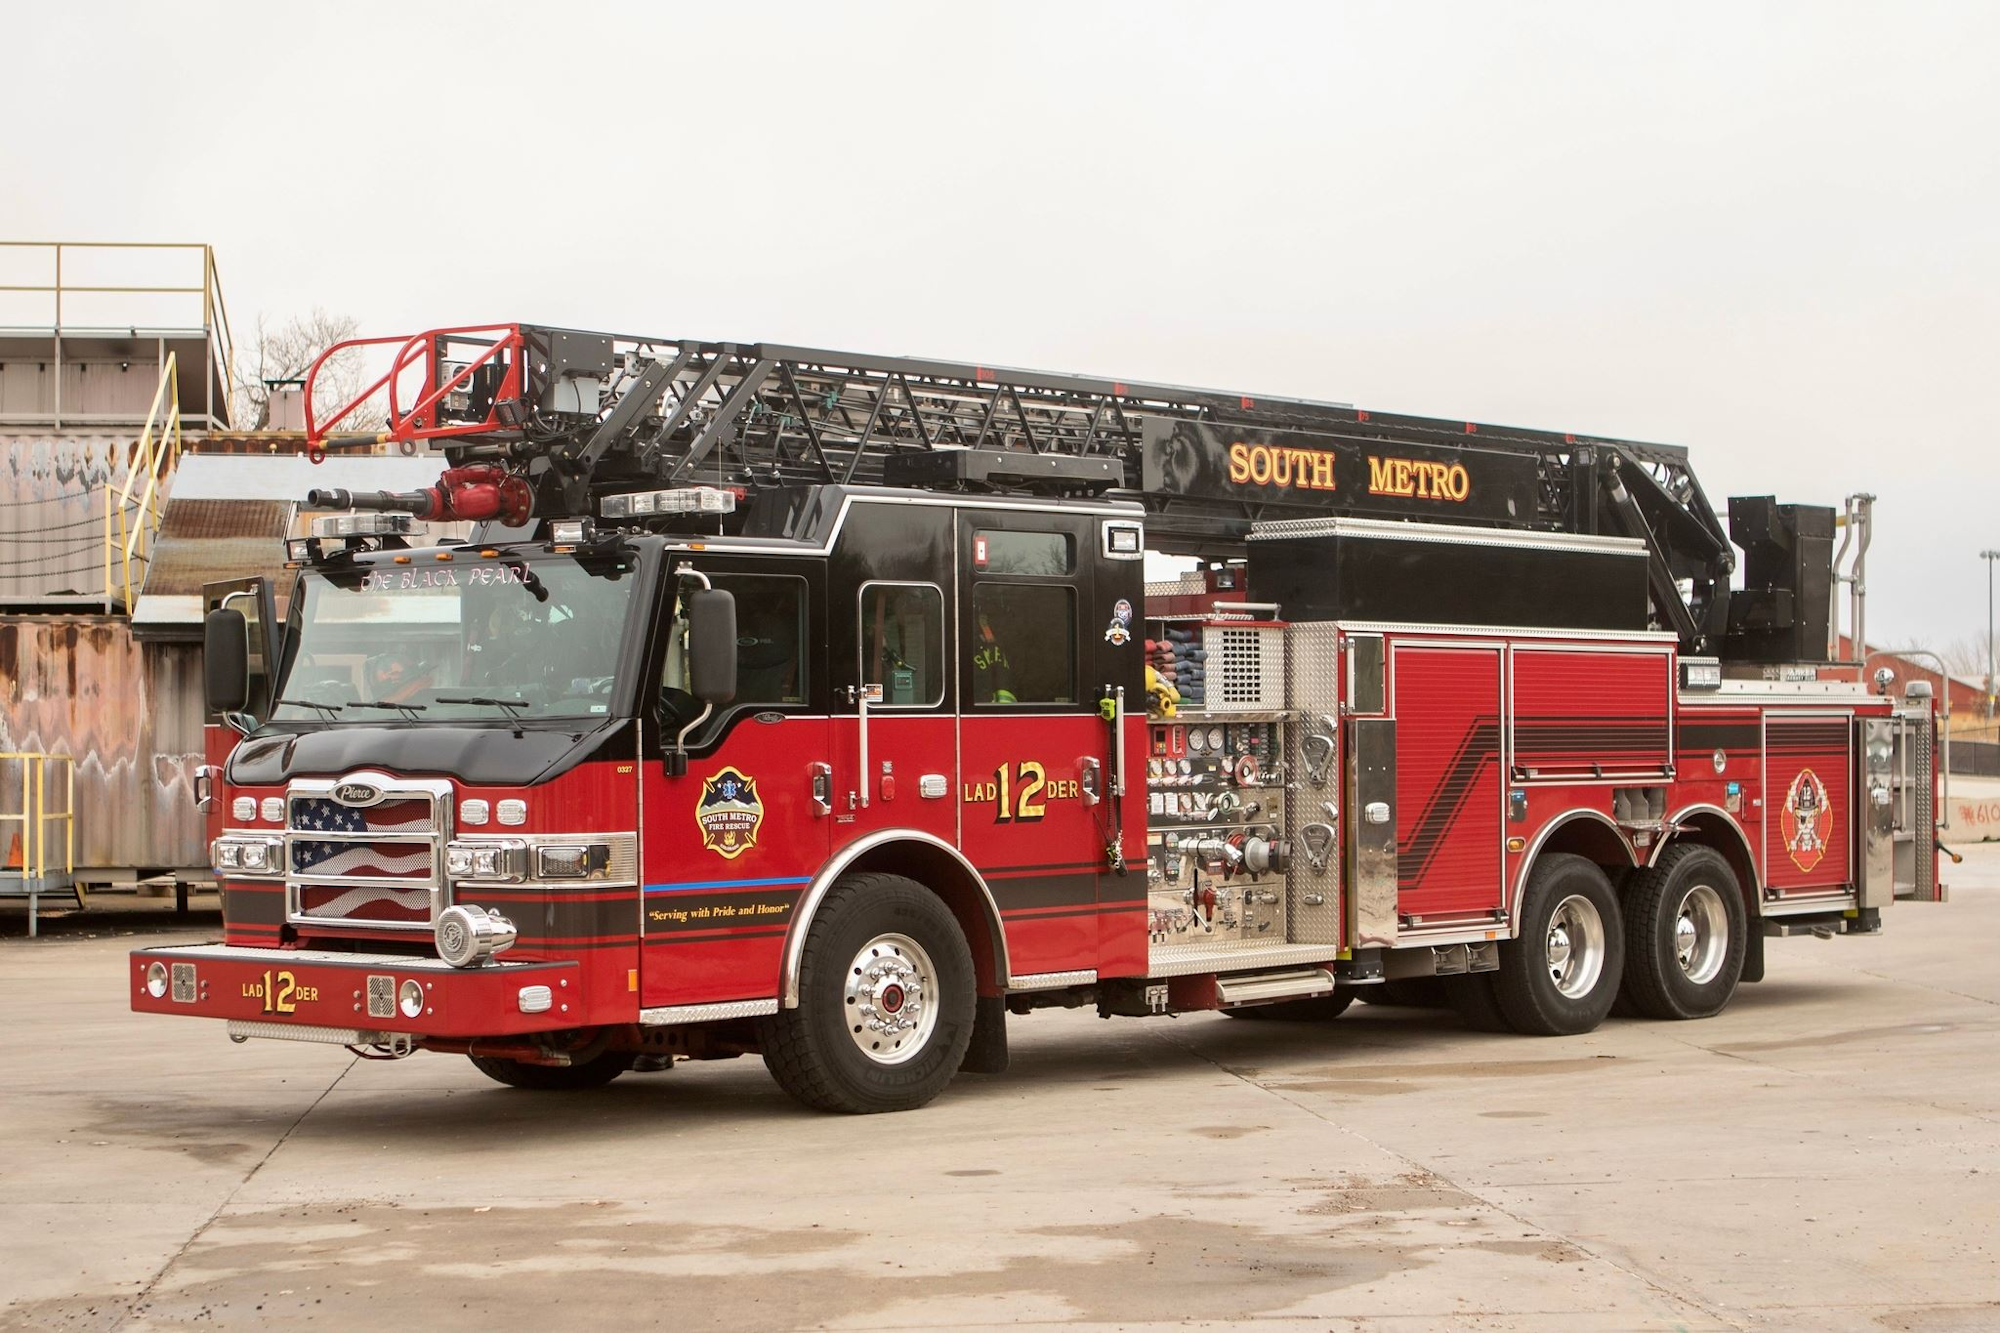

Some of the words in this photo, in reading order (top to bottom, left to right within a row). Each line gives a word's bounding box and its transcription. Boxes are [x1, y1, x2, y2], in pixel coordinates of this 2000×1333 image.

[1229, 442, 1336, 491] SOUTH
[1368, 456, 1470, 502] METRO
[616, 765, 633, 774] 0327
[340, 784, 372, 801] Pierce
[963, 782, 997, 802] LAD
[995, 761, 1047, 822] 12
[1047, 779, 1079, 800] DER
[702, 813, 728, 825] SOUTH
[730, 812, 757, 823] METRO
[709, 823, 725, 831] FIRE
[725, 822, 751, 830] RESCUE
[690, 907, 710, 918] with
[713, 905, 736, 917] Pride
[738, 904, 755, 915] and
[242, 983, 264, 998] LAD
[261, 970, 297, 1015] 12
[296, 987, 319, 1001] DER
